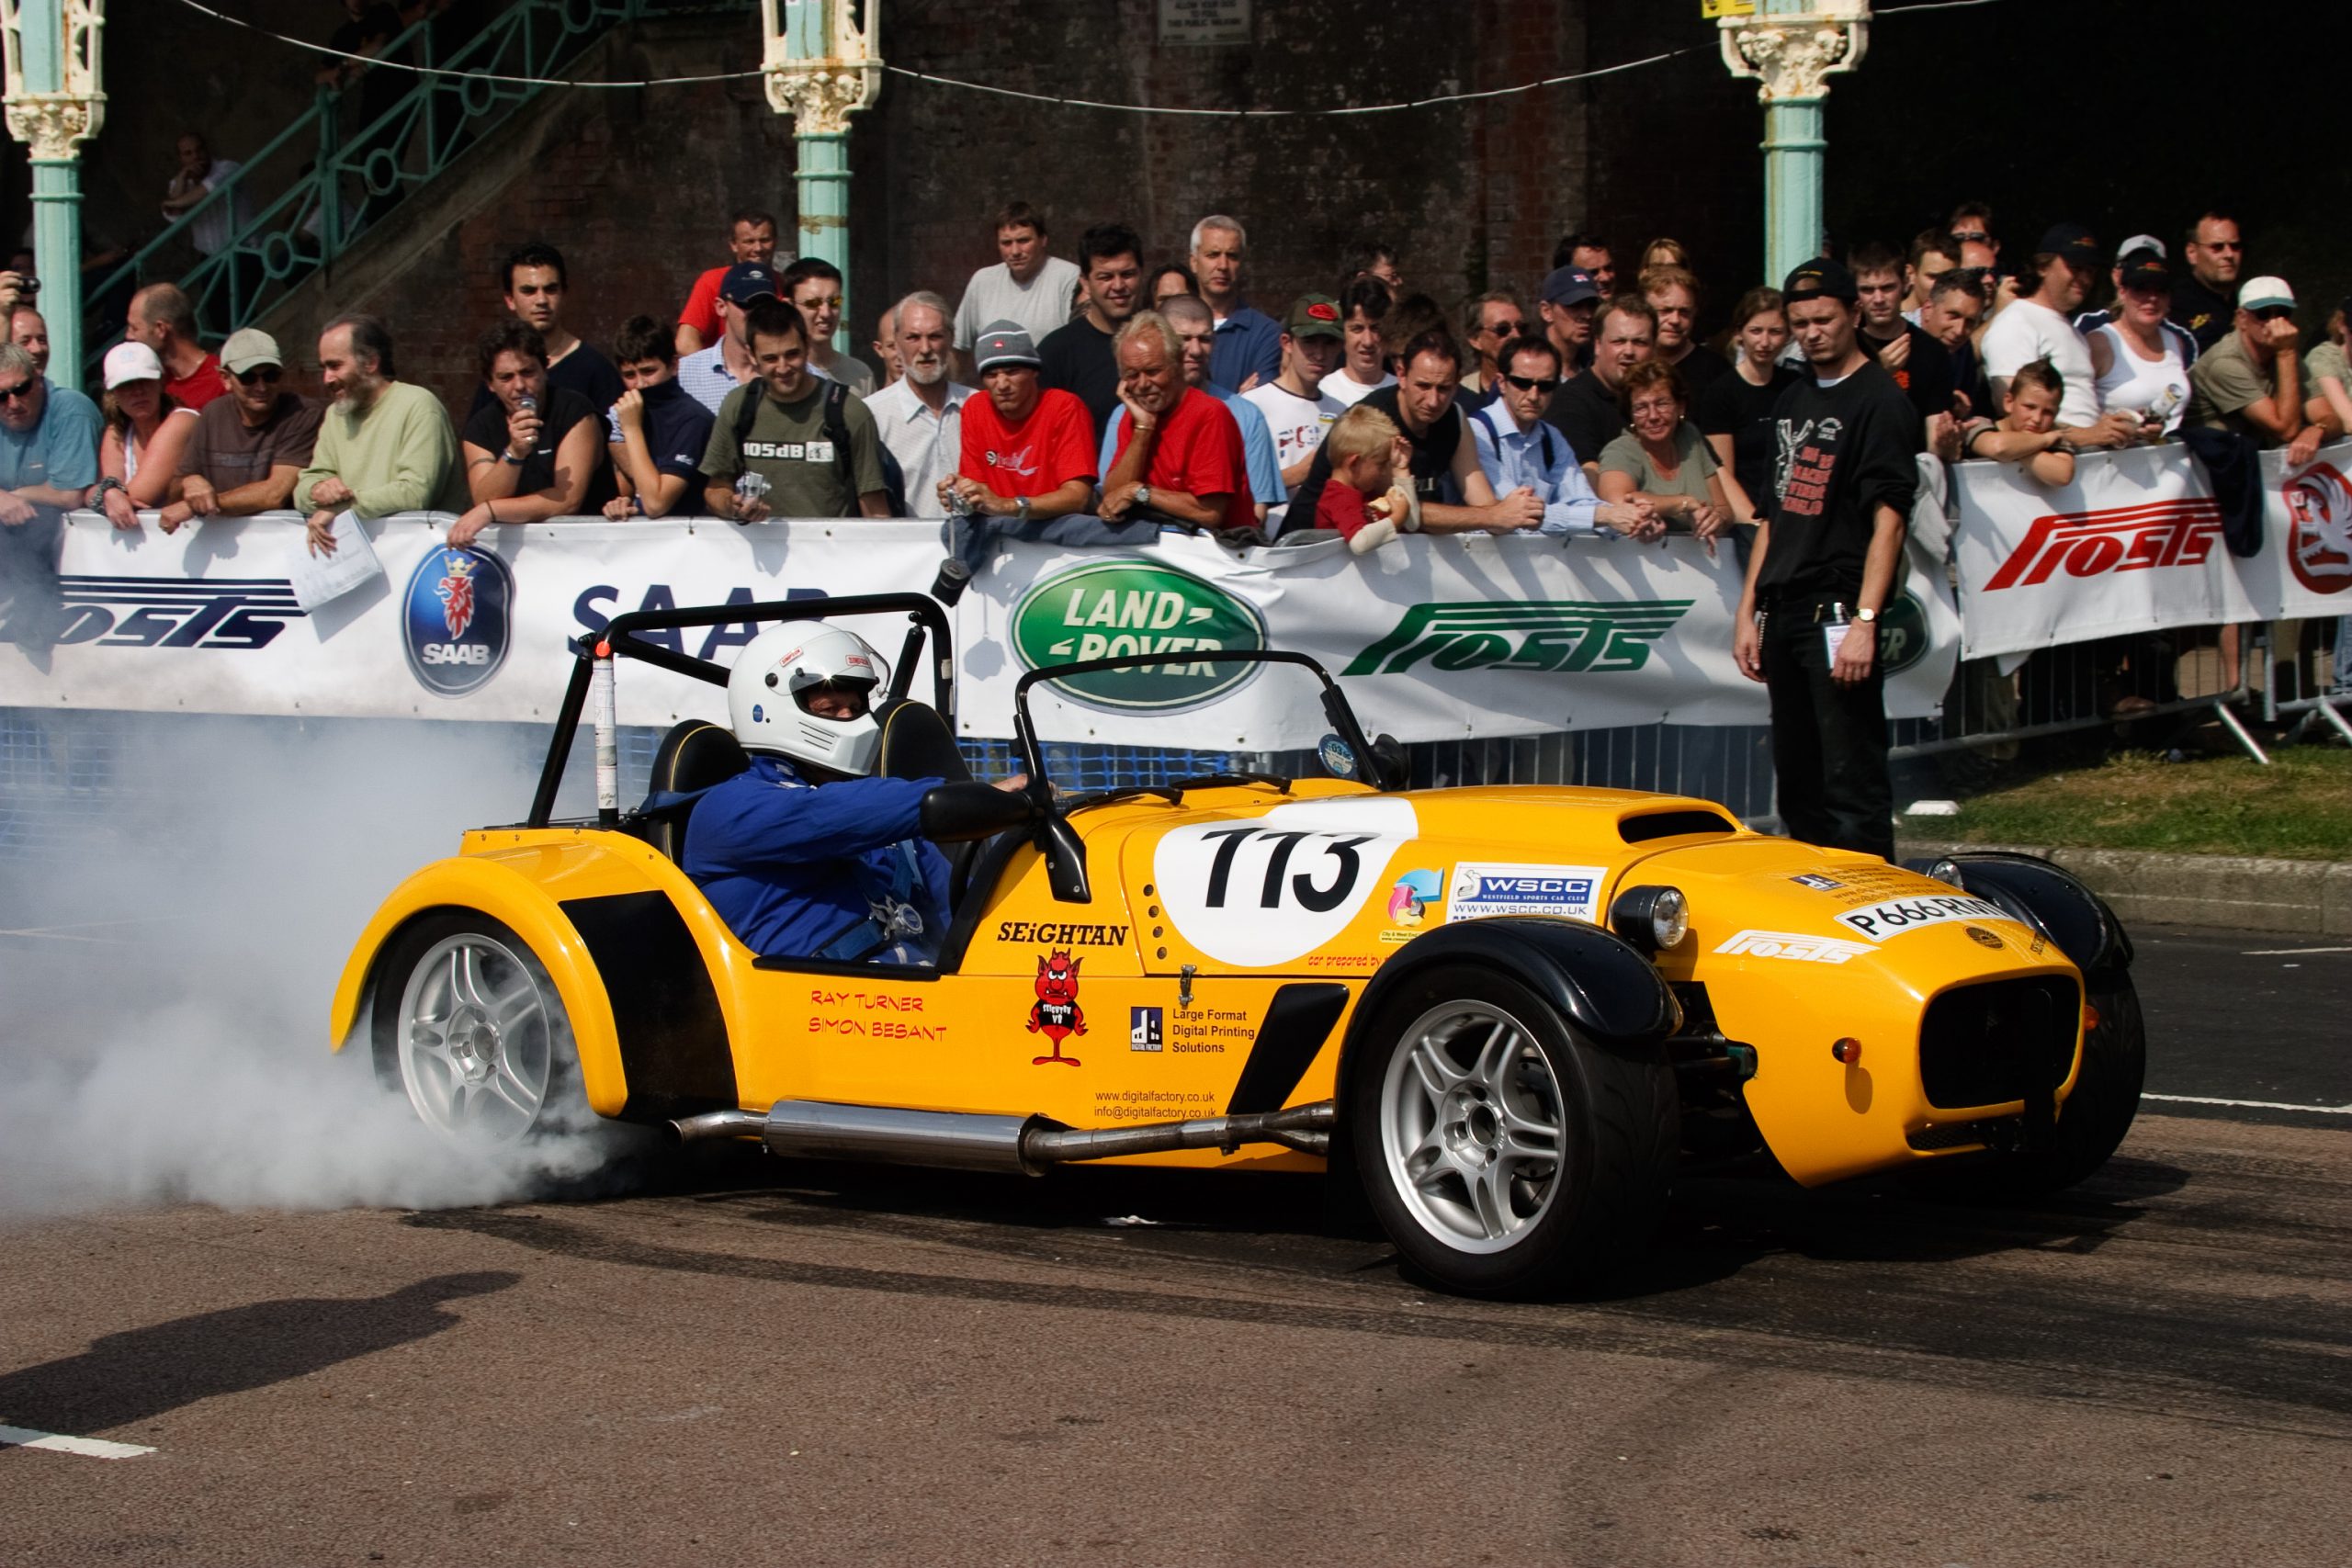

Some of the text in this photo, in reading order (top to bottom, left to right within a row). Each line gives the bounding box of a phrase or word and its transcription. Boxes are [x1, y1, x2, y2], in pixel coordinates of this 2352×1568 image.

[1063, 589, 1185, 630] LAND
[422, 643, 489, 666] SAAB
[1076, 634, 1223, 677] ROVER
[1486, 878, 1589, 893] WSCC
[1454, 904, 1588, 915] WWW.WSCC.CO.UK
[1308, 956, 1323, 966] car
[1326, 953, 1368, 970] prepared
[810, 990, 924, 1012] RAY TURNER
[1172, 1009, 1247, 1022] Large Format
[808, 1017, 947, 1042] SIMON BESANT
[1172, 1024, 1255, 1040] Digital Printing
[1172, 1042, 1225, 1053] Solutions
[1095, 1090, 1216, 1104] www.digitalfactory.co.uk
[1094, 1105, 1216, 1120] info@digitalfactory.co.uk
